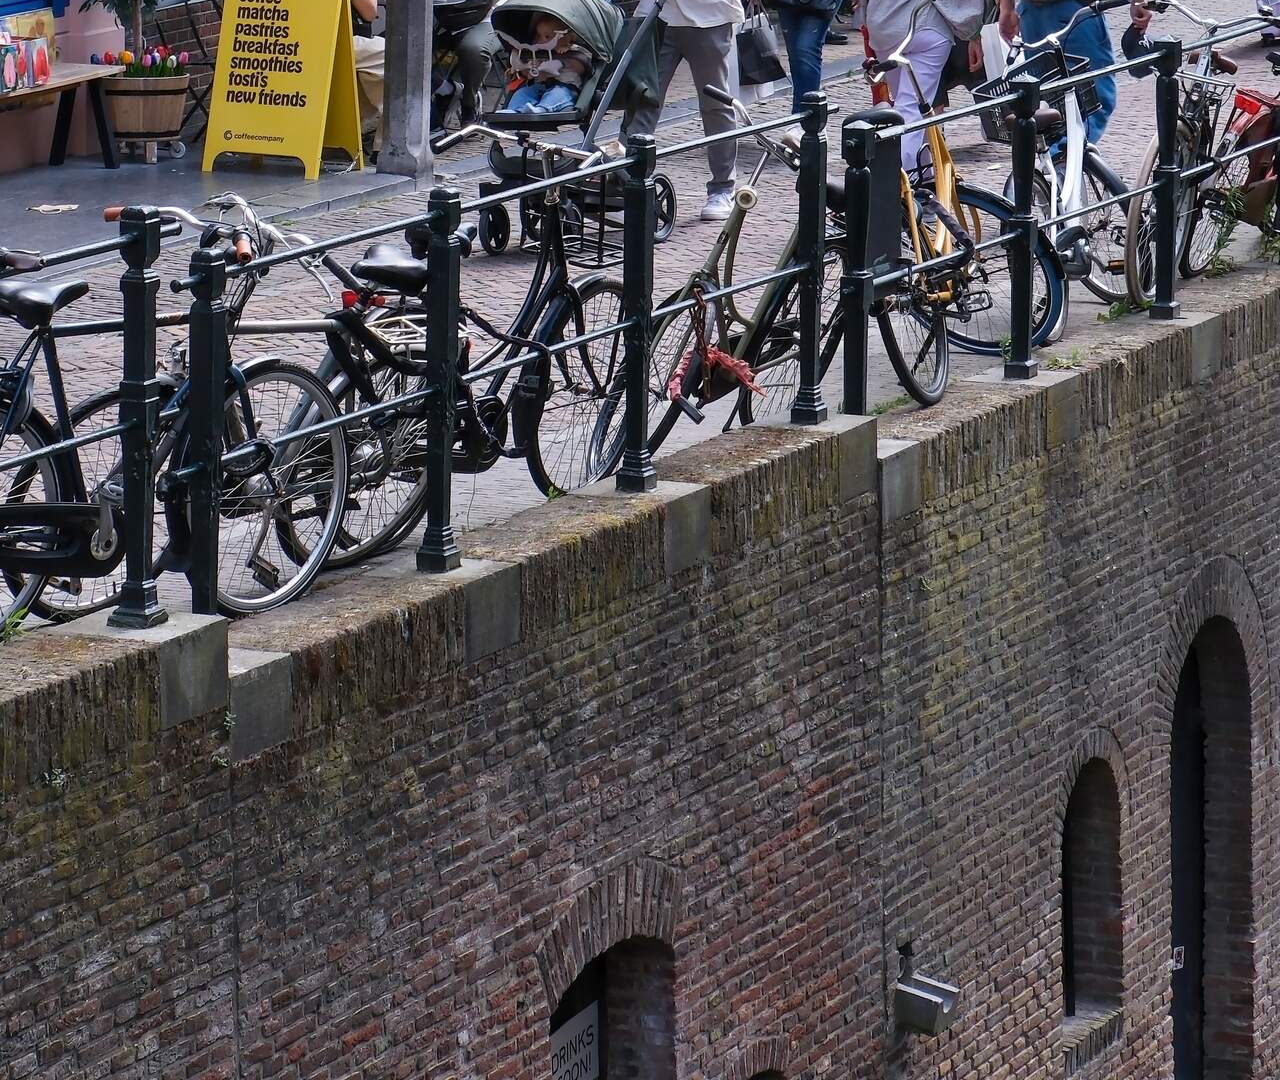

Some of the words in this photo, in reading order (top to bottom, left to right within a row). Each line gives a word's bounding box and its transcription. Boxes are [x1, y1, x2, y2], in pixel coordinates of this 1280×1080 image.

[237, 5, 289, 22] matcha
[235, 21, 290, 39] pastries
[232, 36, 300, 57] breakfast
[230, 55, 303, 74] smoothies
[228, 70, 269, 89] tosti's
[225, 89, 256, 104] new
[257, 88, 307, 108] friends
[233, 132, 285, 144] coffeecompany
